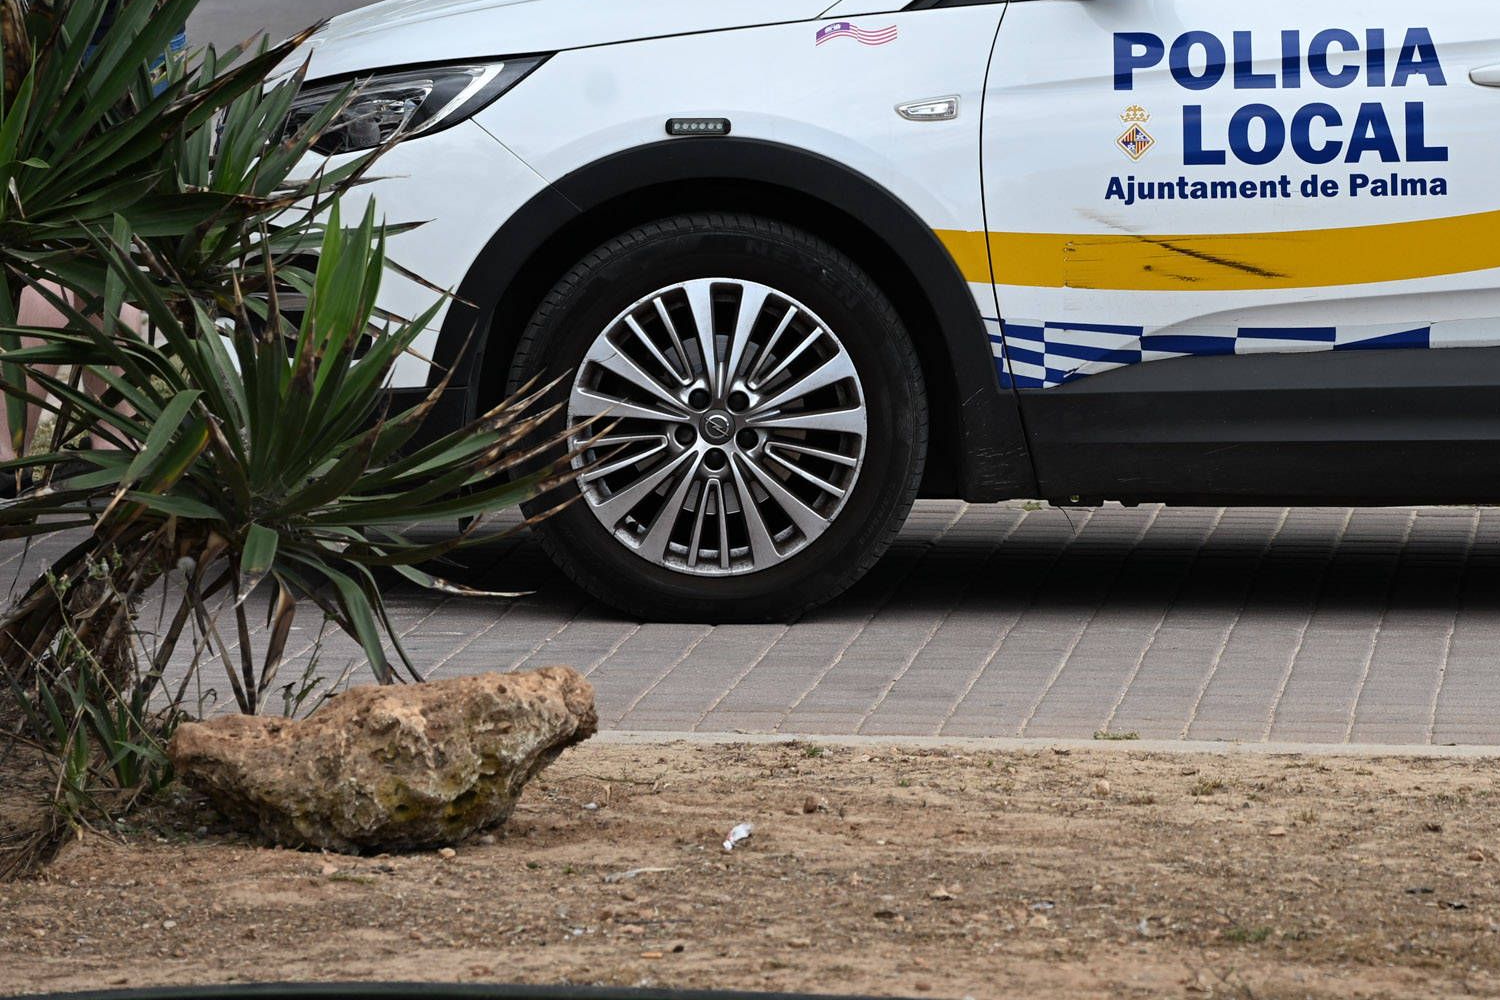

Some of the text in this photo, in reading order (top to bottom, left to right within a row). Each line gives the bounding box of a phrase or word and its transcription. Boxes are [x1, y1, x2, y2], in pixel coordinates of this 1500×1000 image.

[1113, 27, 1447, 91] POLICIA
[1182, 101, 1449, 166] LOCAL
[1105, 173, 1448, 205] Ajuntament de Palma
